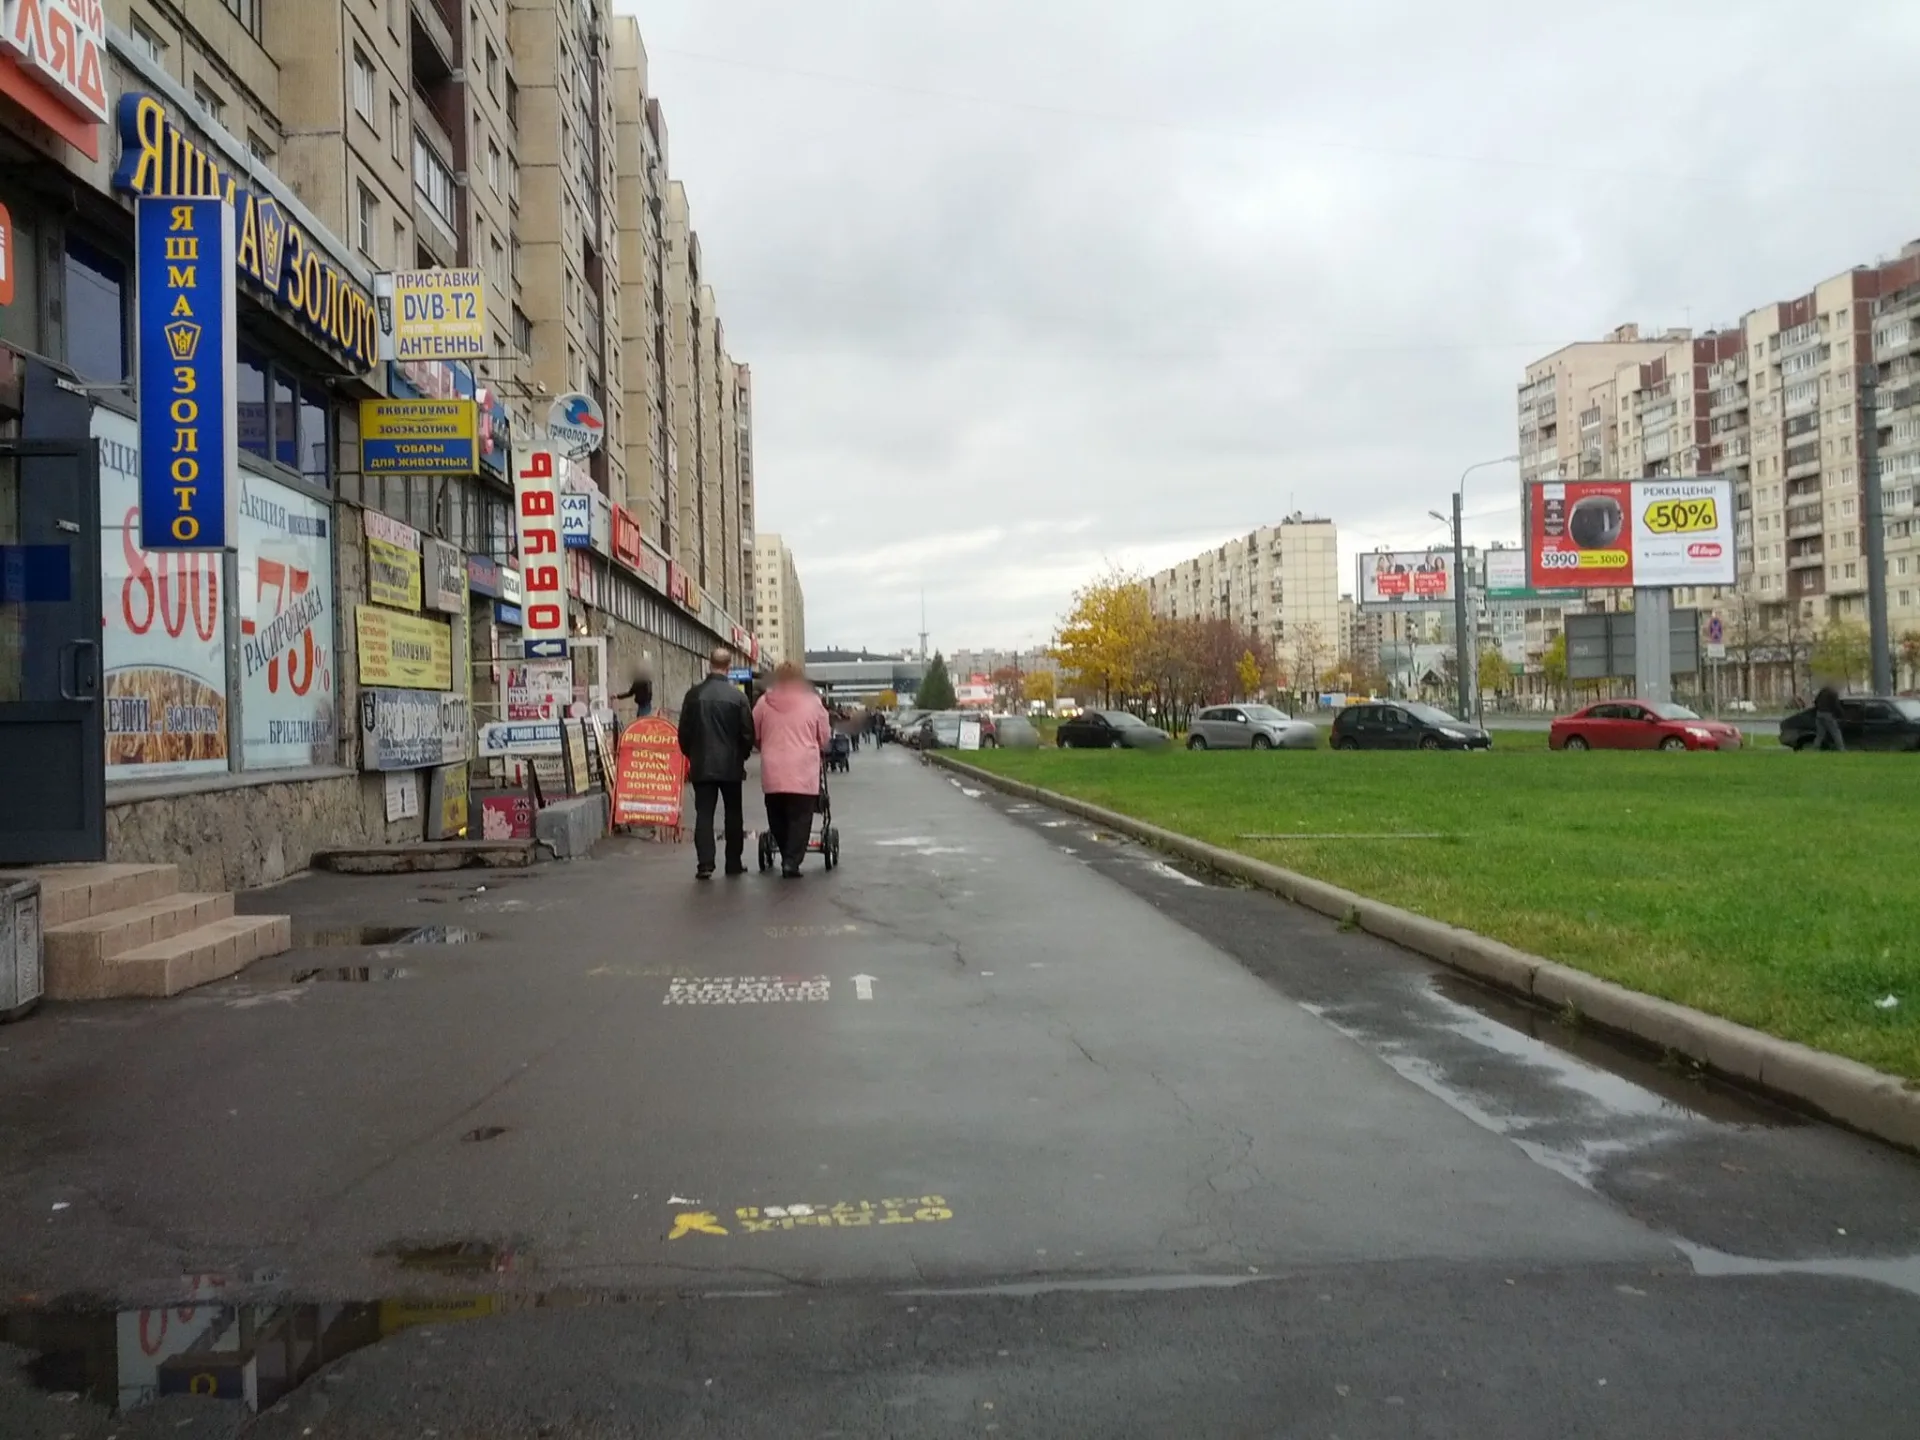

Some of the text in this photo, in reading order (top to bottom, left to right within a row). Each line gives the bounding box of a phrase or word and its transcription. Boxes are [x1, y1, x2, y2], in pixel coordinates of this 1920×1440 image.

[164, 205, 199, 317] ЯШМА
[396, 271, 480, 289] ПРИСТАВКИ
[287, 223, 379, 369] ЗОЛОТО
[403, 292, 477, 321] DVB-T2
[399, 335, 484, 355] АНТЕННЫ
[170, 366, 200, 541] ЗОЛОТО
[394, 444, 445, 454] ТОВАРЫ
[370, 457, 469, 468] ДЛЯ ЖИВОТНЫХ
[1643, 486, 1680, 496] РЕЖЕМ
[519, 452, 561, 630] ОБУВЬ
[564, 537, 588, 545] ТИЛЬ
[1543, 553, 1578, 567] 3990
[1600, 555, 1626, 565] 3000
[104, 698, 150, 733] ЕПИ
[624, 733, 678, 745] РЕМОНТ
